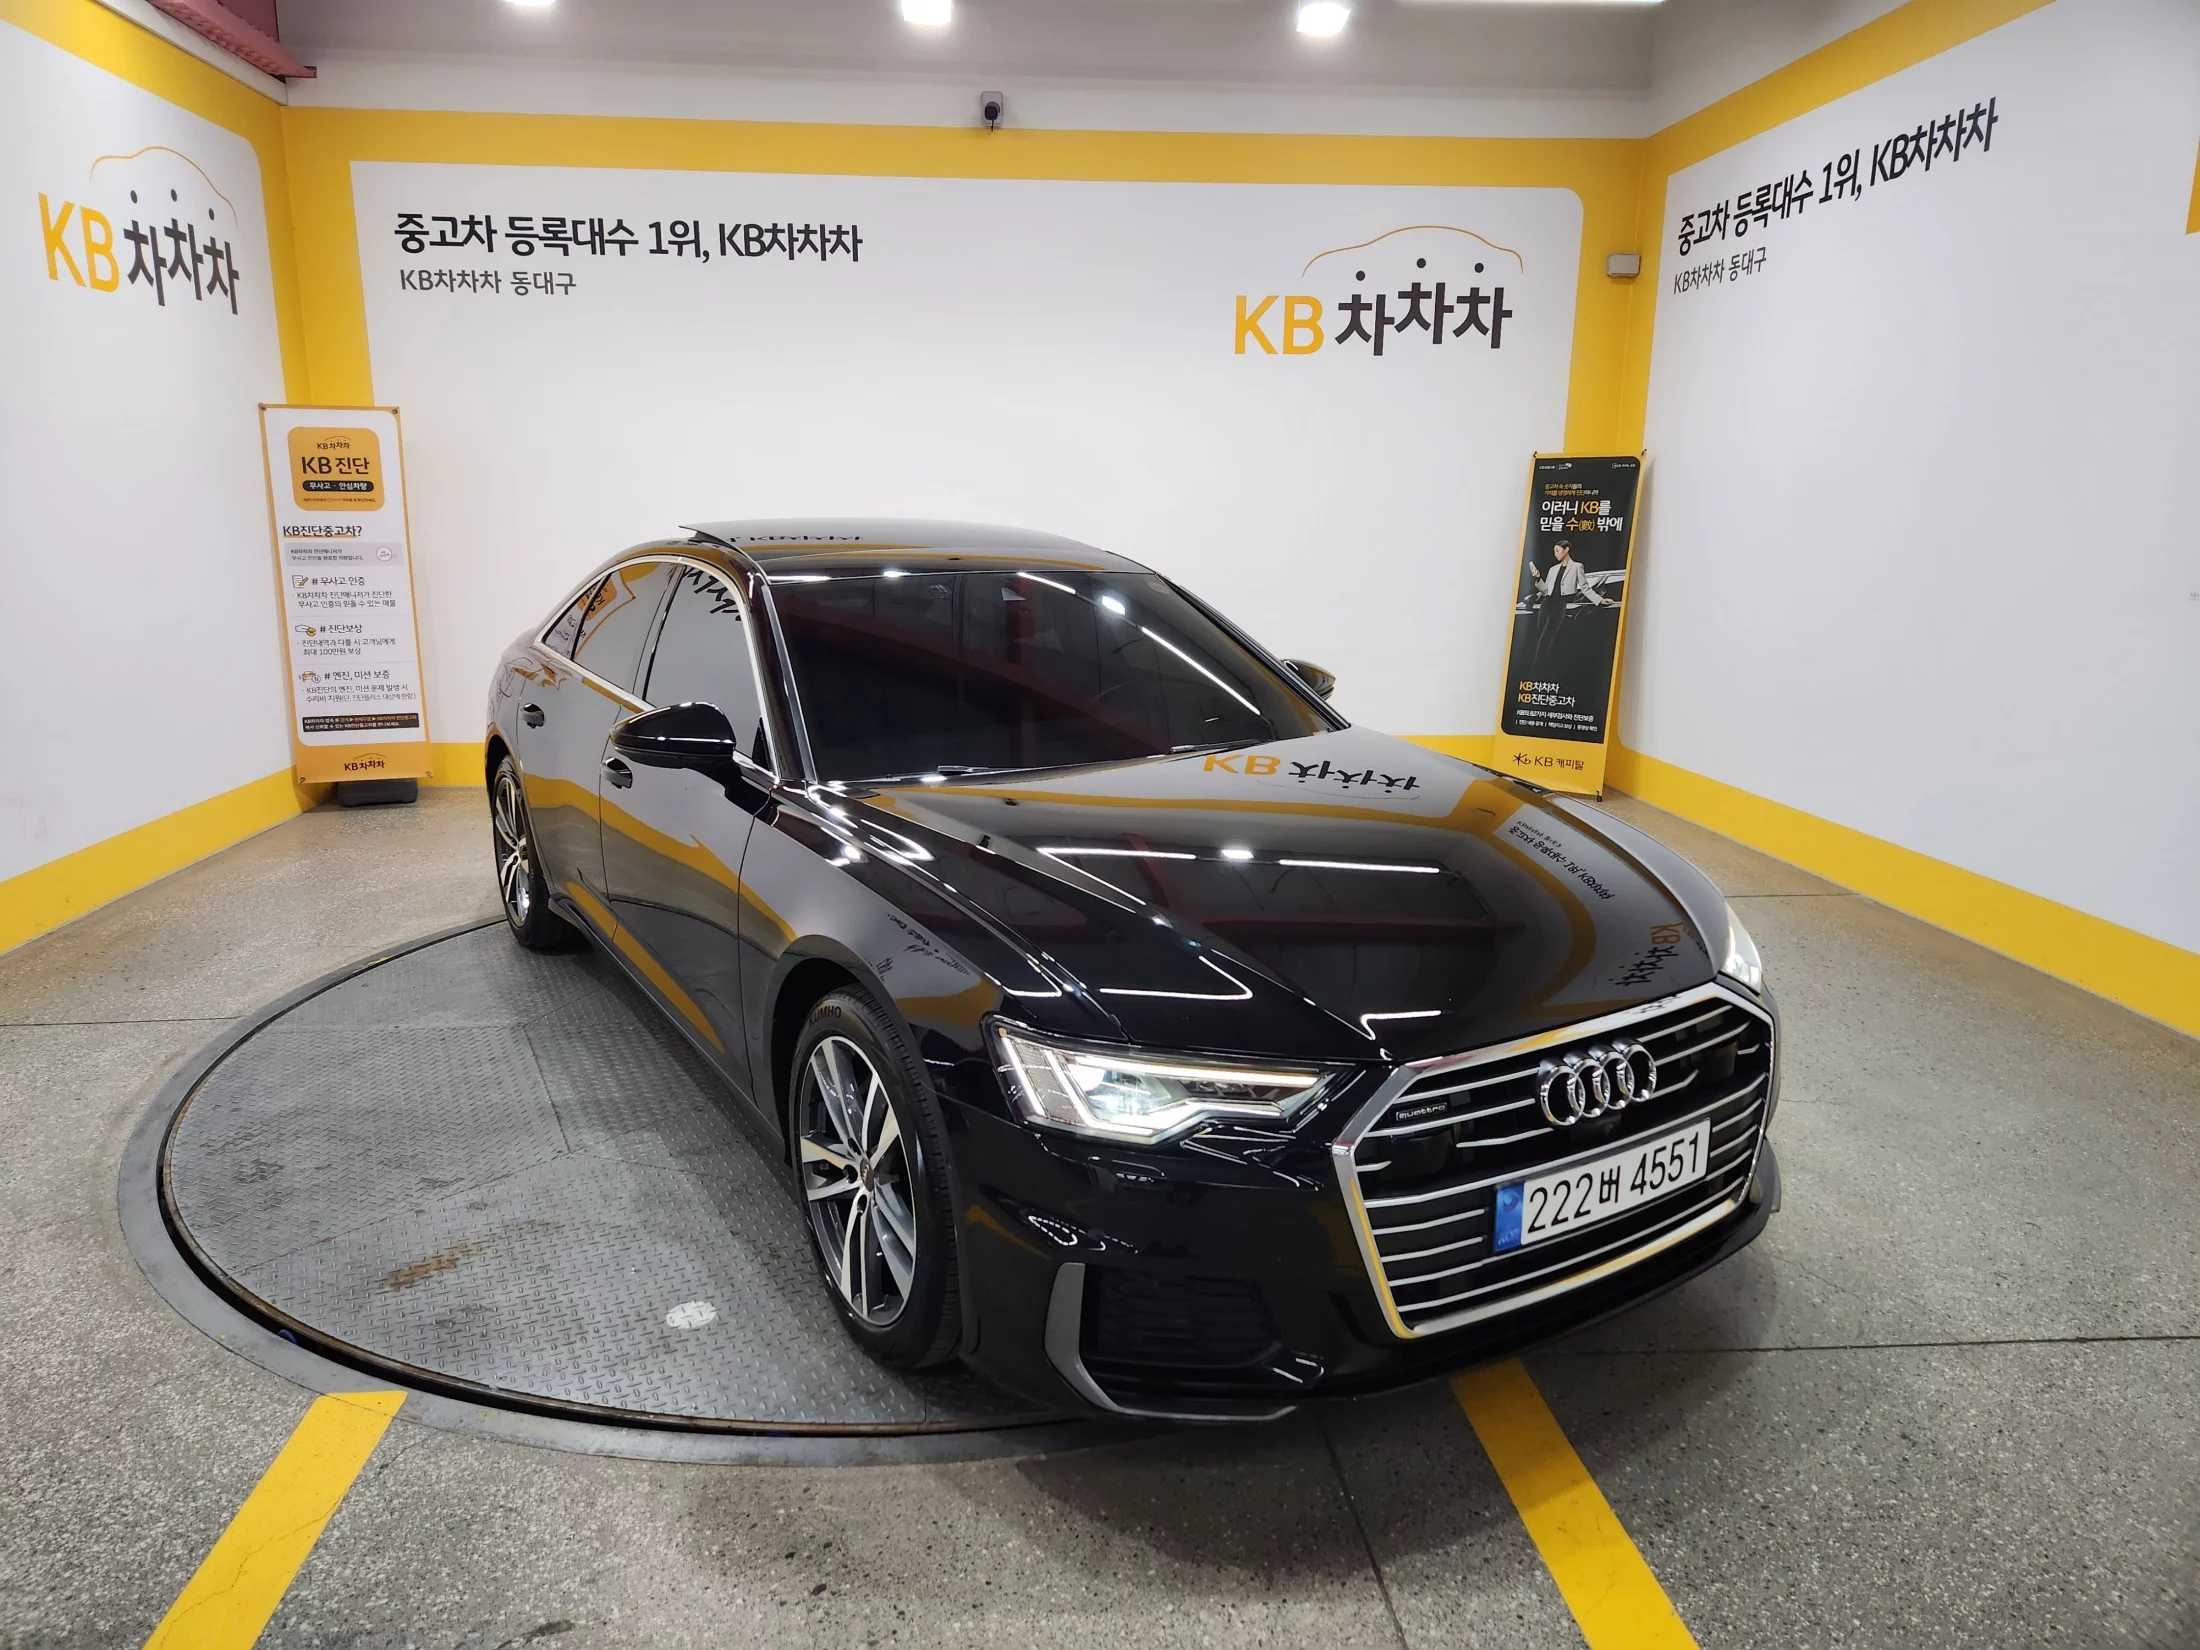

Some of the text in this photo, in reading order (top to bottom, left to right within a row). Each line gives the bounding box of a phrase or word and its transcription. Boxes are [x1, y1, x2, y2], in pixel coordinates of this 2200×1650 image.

[1678, 96, 1999, 257] 중고차 등록대수 1위, KB차차차
[394, 212, 864, 264] 중고차 등록대수 1위, KB차차차
[37, 188, 241, 316] KB 차차차
[1673, 246, 1767, 295] KB차차차 동대구
[399, 268, 577, 296] KB차차차 동대구
[1234, 257, 1513, 356] KB 차차차
[301, 456, 370, 475] KB 진단
[309, 482, 331, 490] 무사고
[1541, 500, 1612, 515] 이러니 KB를
[283, 525, 362, 537] KB진단중고차?
[1540, 516, 1564, 531] 믿을
[1597, 516, 1623, 532] 밖에
[320, 576, 347, 586] 무사고
[348, 576, 365, 586] 인증
[328, 624, 363, 634] 진단보상
[347, 647, 361, 655] 보상
[354, 670, 372, 680] 미션
[373, 669, 391, 680] 보증
[1519, 680, 1560, 694] KB차차차
[1517, 693, 1576, 707] KB진단중고차
[1534, 755, 1585, 771] KB 캐피탈
[808, 1005, 842, 1028] KUMHO
[1398, 1105, 1446, 1120] quattro
[1527, 1130, 1700, 1234] 222버 4551
